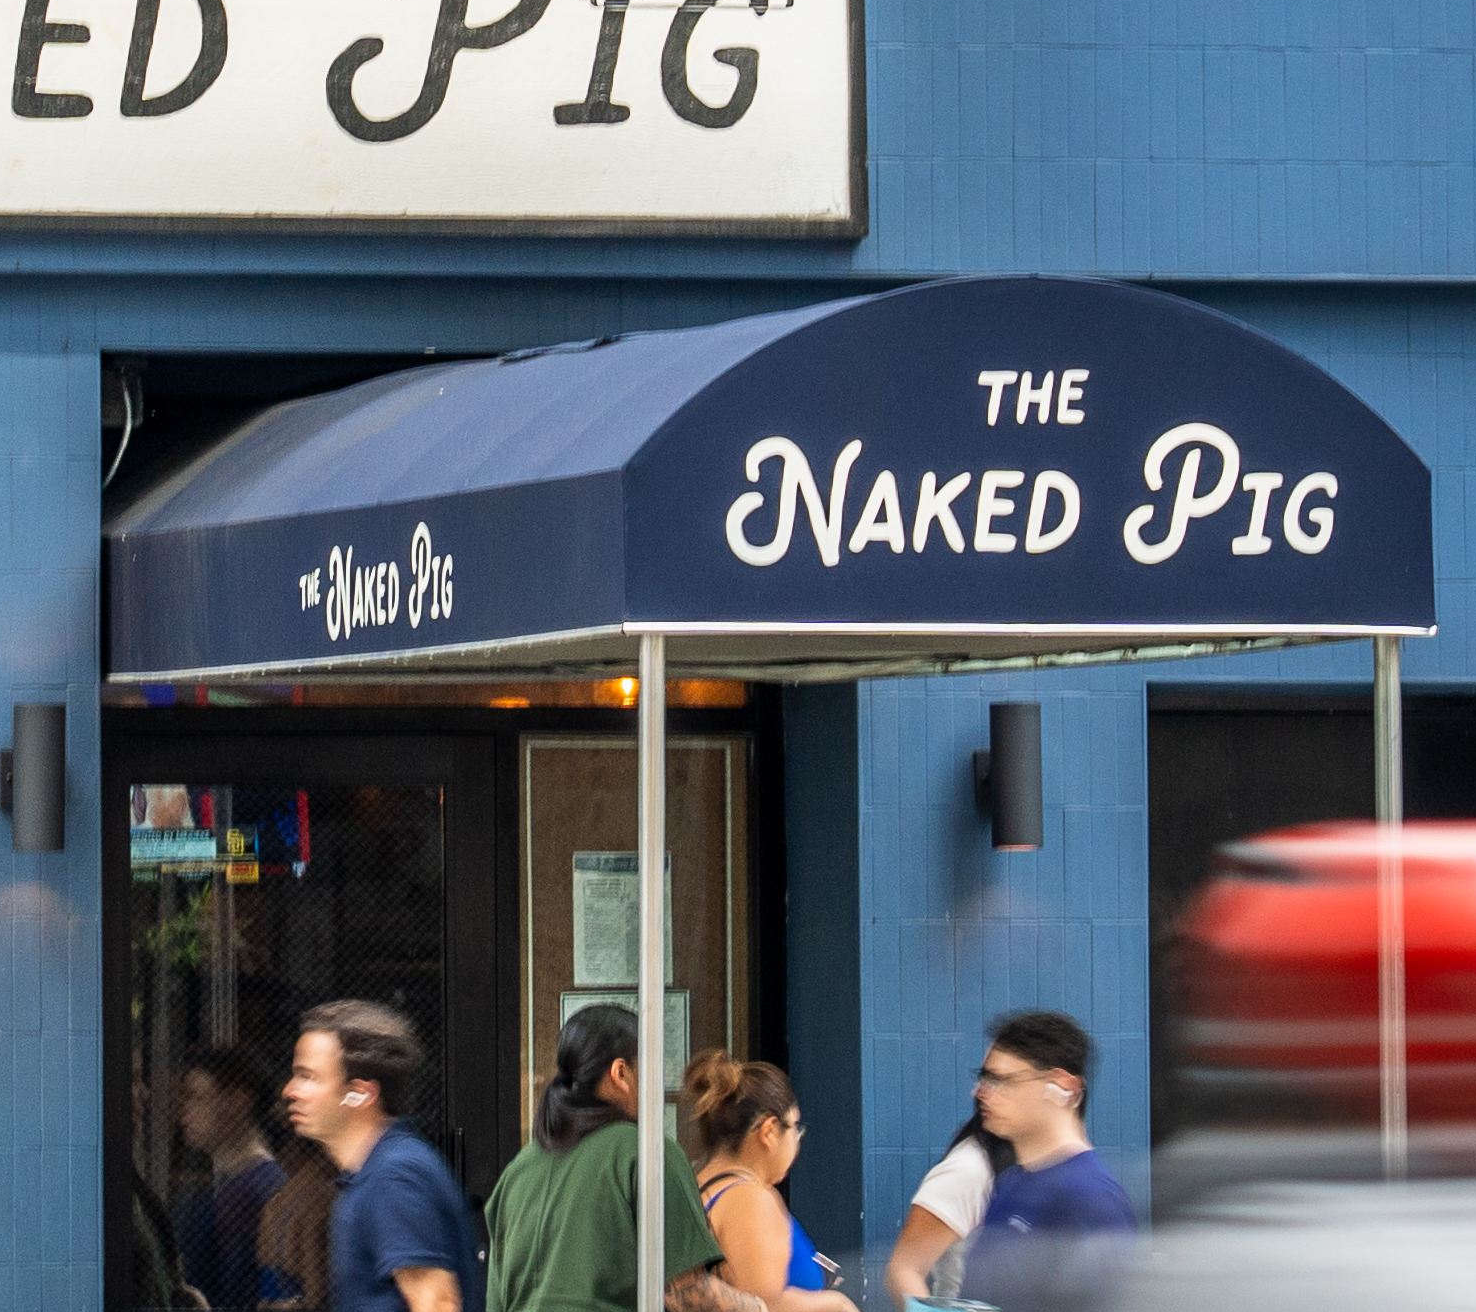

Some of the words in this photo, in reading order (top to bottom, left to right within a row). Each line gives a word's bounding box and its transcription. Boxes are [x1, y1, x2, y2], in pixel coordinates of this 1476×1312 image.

[978, 368, 1090, 427] THE
[725, 436, 1081, 567] NAKED
[1123, 422, 1338, 564] PIG
[299, 567, 320, 611] THE
[326, 544, 400, 641] NAKED
[408, 521, 453, 629] PIG
